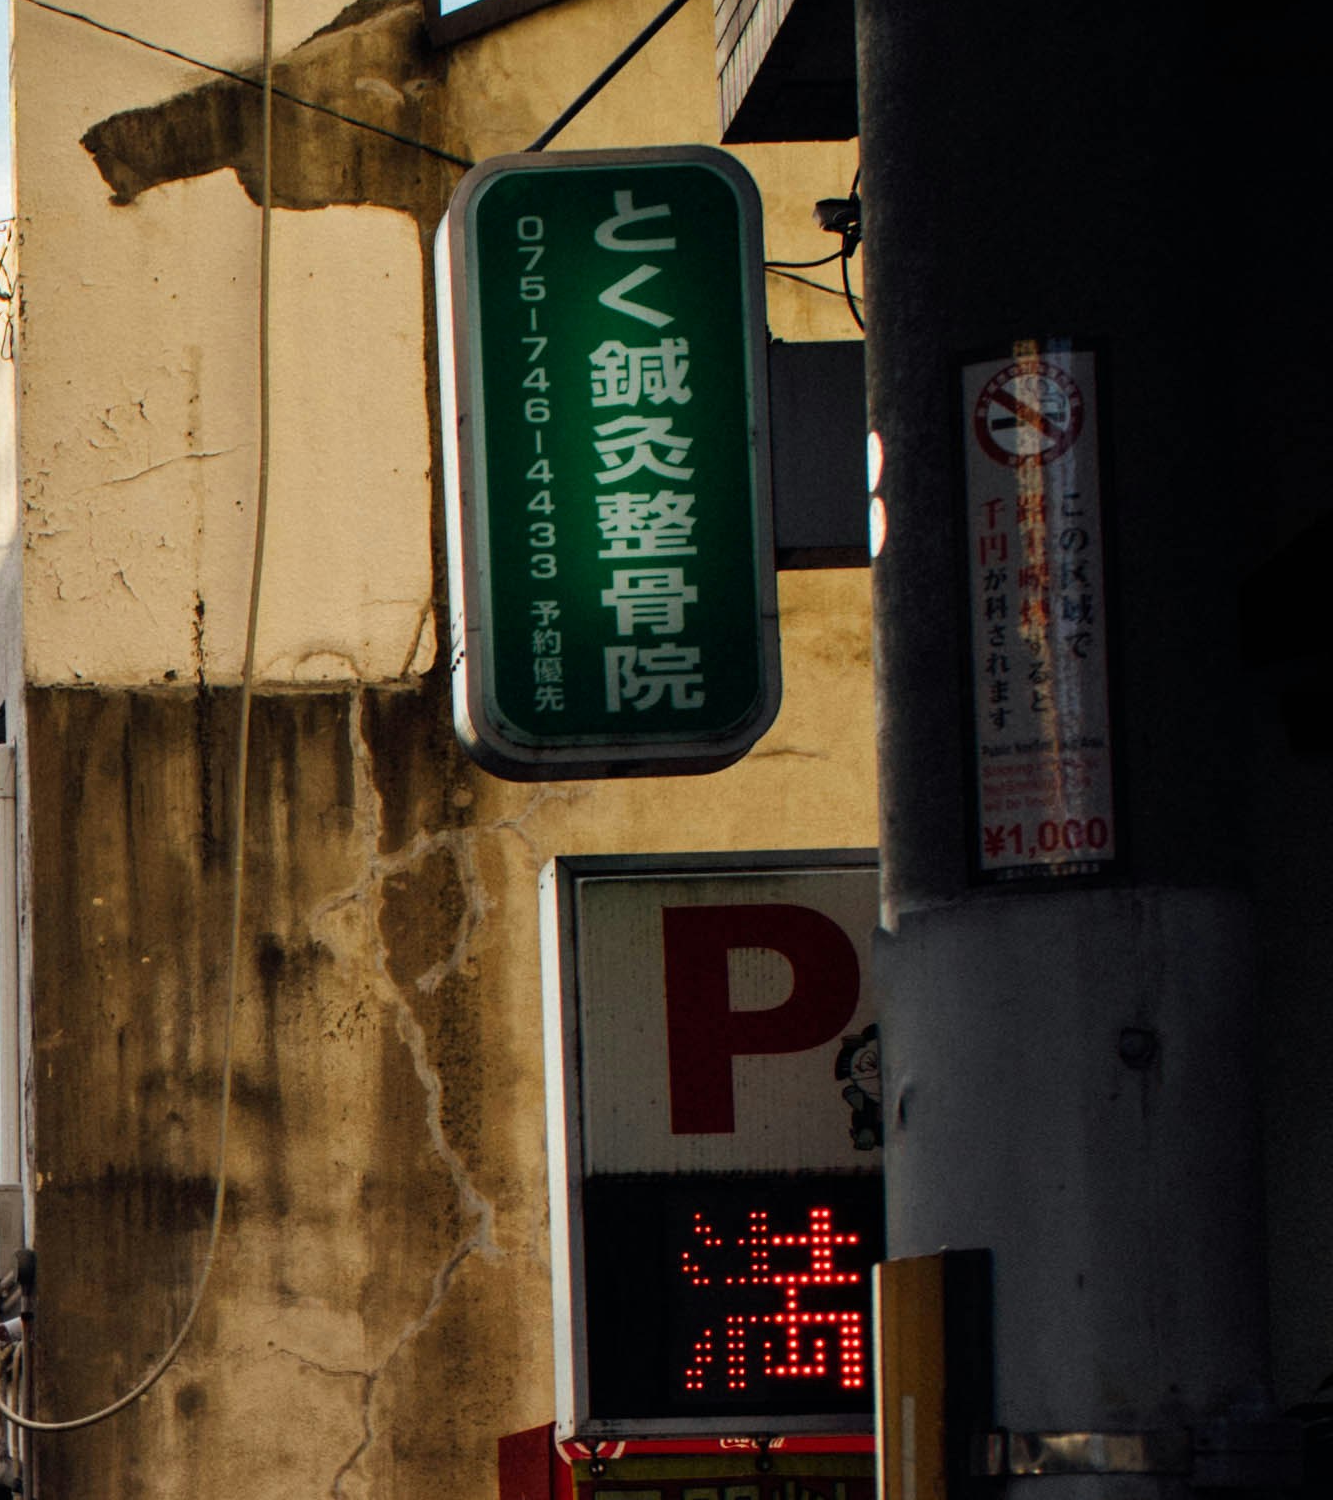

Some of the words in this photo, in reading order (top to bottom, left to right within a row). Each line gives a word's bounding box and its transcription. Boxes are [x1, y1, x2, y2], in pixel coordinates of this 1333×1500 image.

[588, 189, 705, 713] とく鍼灸整骨院
[530, 599, 565, 712] 予約優先
[984, 817, 1107, 858] ¥1,000
[662, 904, 861, 1134] P
[683, 1208, 864, 1389] 満
